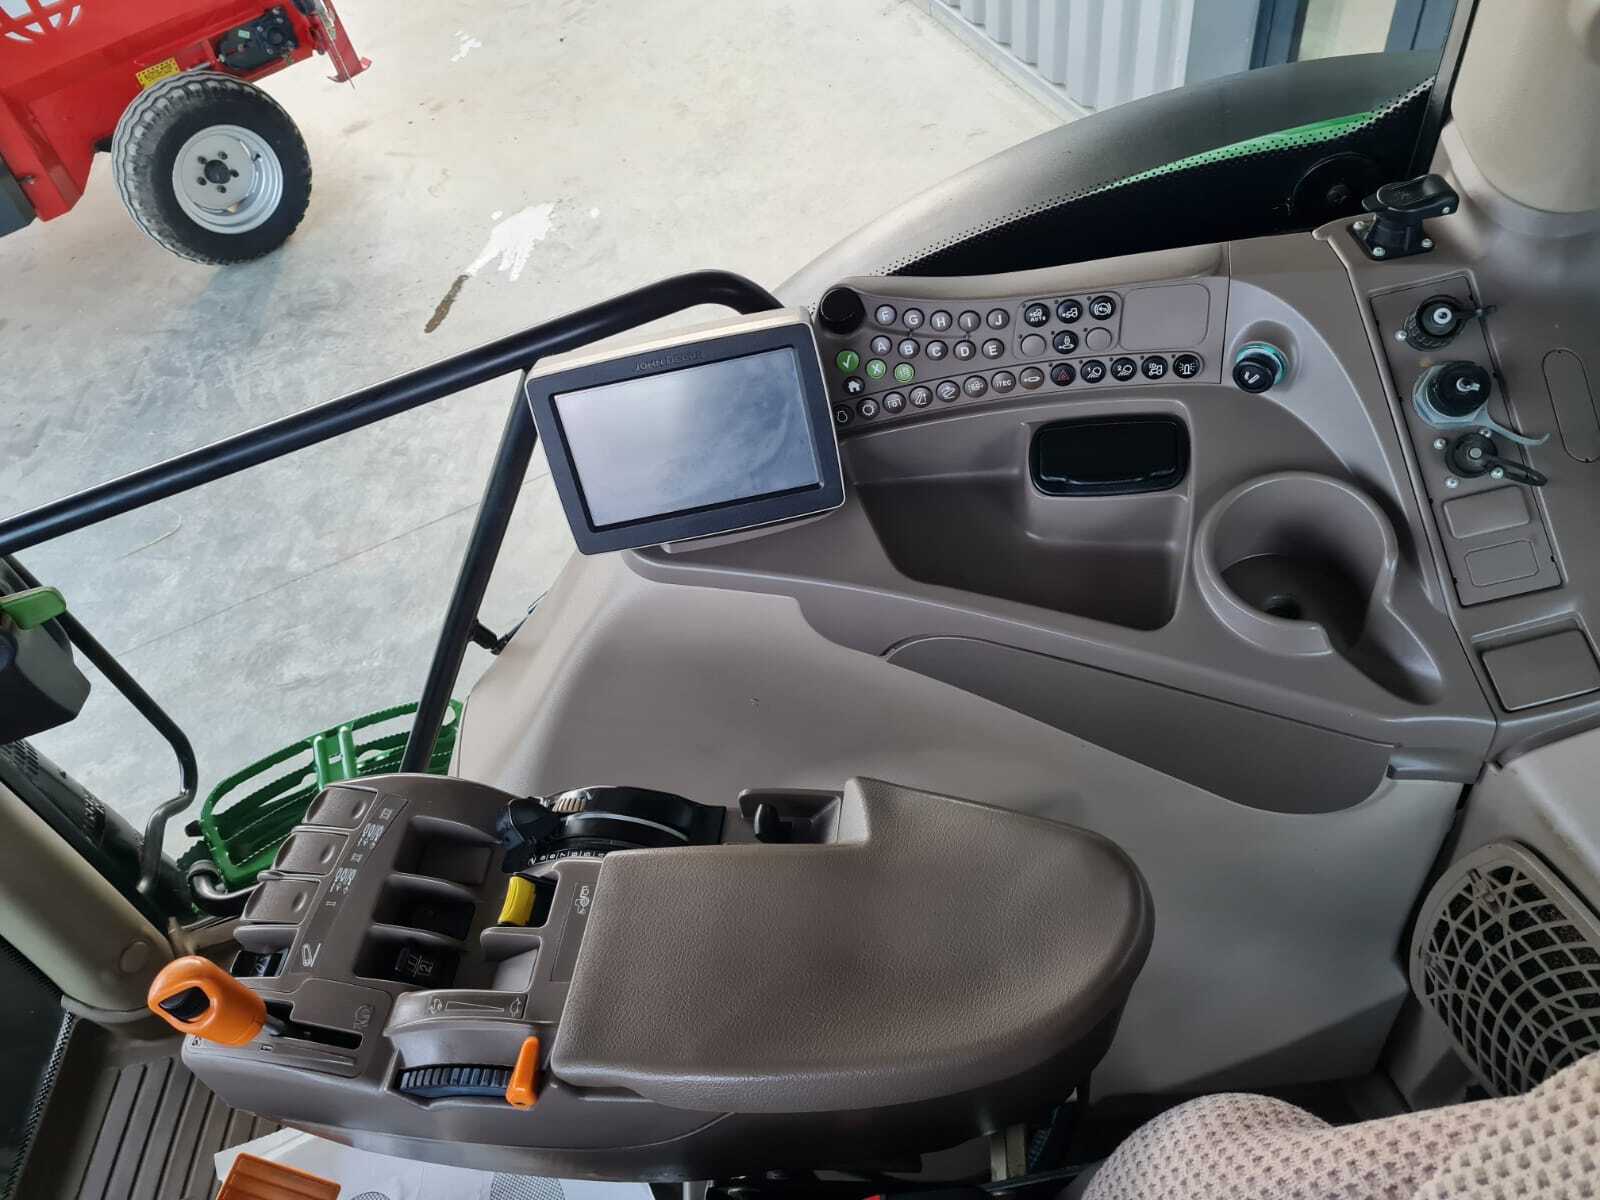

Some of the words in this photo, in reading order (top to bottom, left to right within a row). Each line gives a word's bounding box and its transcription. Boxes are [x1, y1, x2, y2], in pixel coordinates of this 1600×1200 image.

[881, 311, 889, 320] F
[908, 314, 919, 325] G
[995, 313, 1003, 325] J
[936, 317, 946, 327] H
[878, 342, 887, 352] A
[904, 344, 914, 355] B
[932, 347, 942, 357] C
[960, 346, 970, 357] D
[988, 345, 998, 355] E
